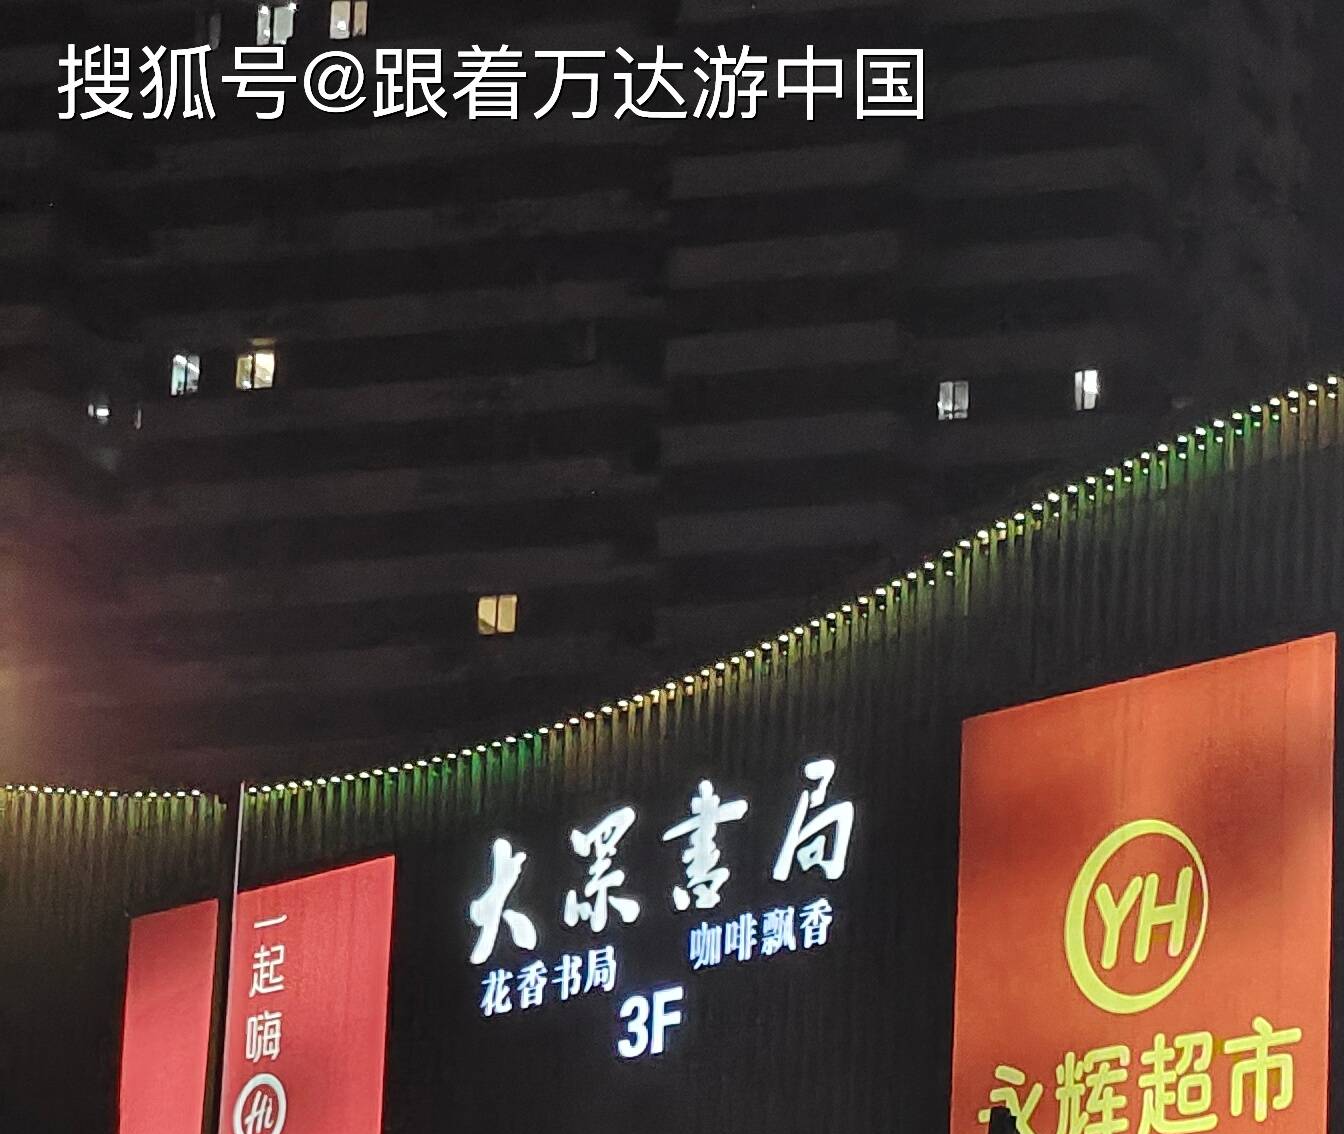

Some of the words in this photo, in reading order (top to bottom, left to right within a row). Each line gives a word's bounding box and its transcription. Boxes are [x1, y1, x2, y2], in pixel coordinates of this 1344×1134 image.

[690, 898, 834, 971] 咖啡飘香
[1095, 866, 1194, 970] YH
[245, 914, 288, 1063] 一起嗨
[479, 946, 618, 1017] 花香书局
[617, 985, 684, 1058] 3F
